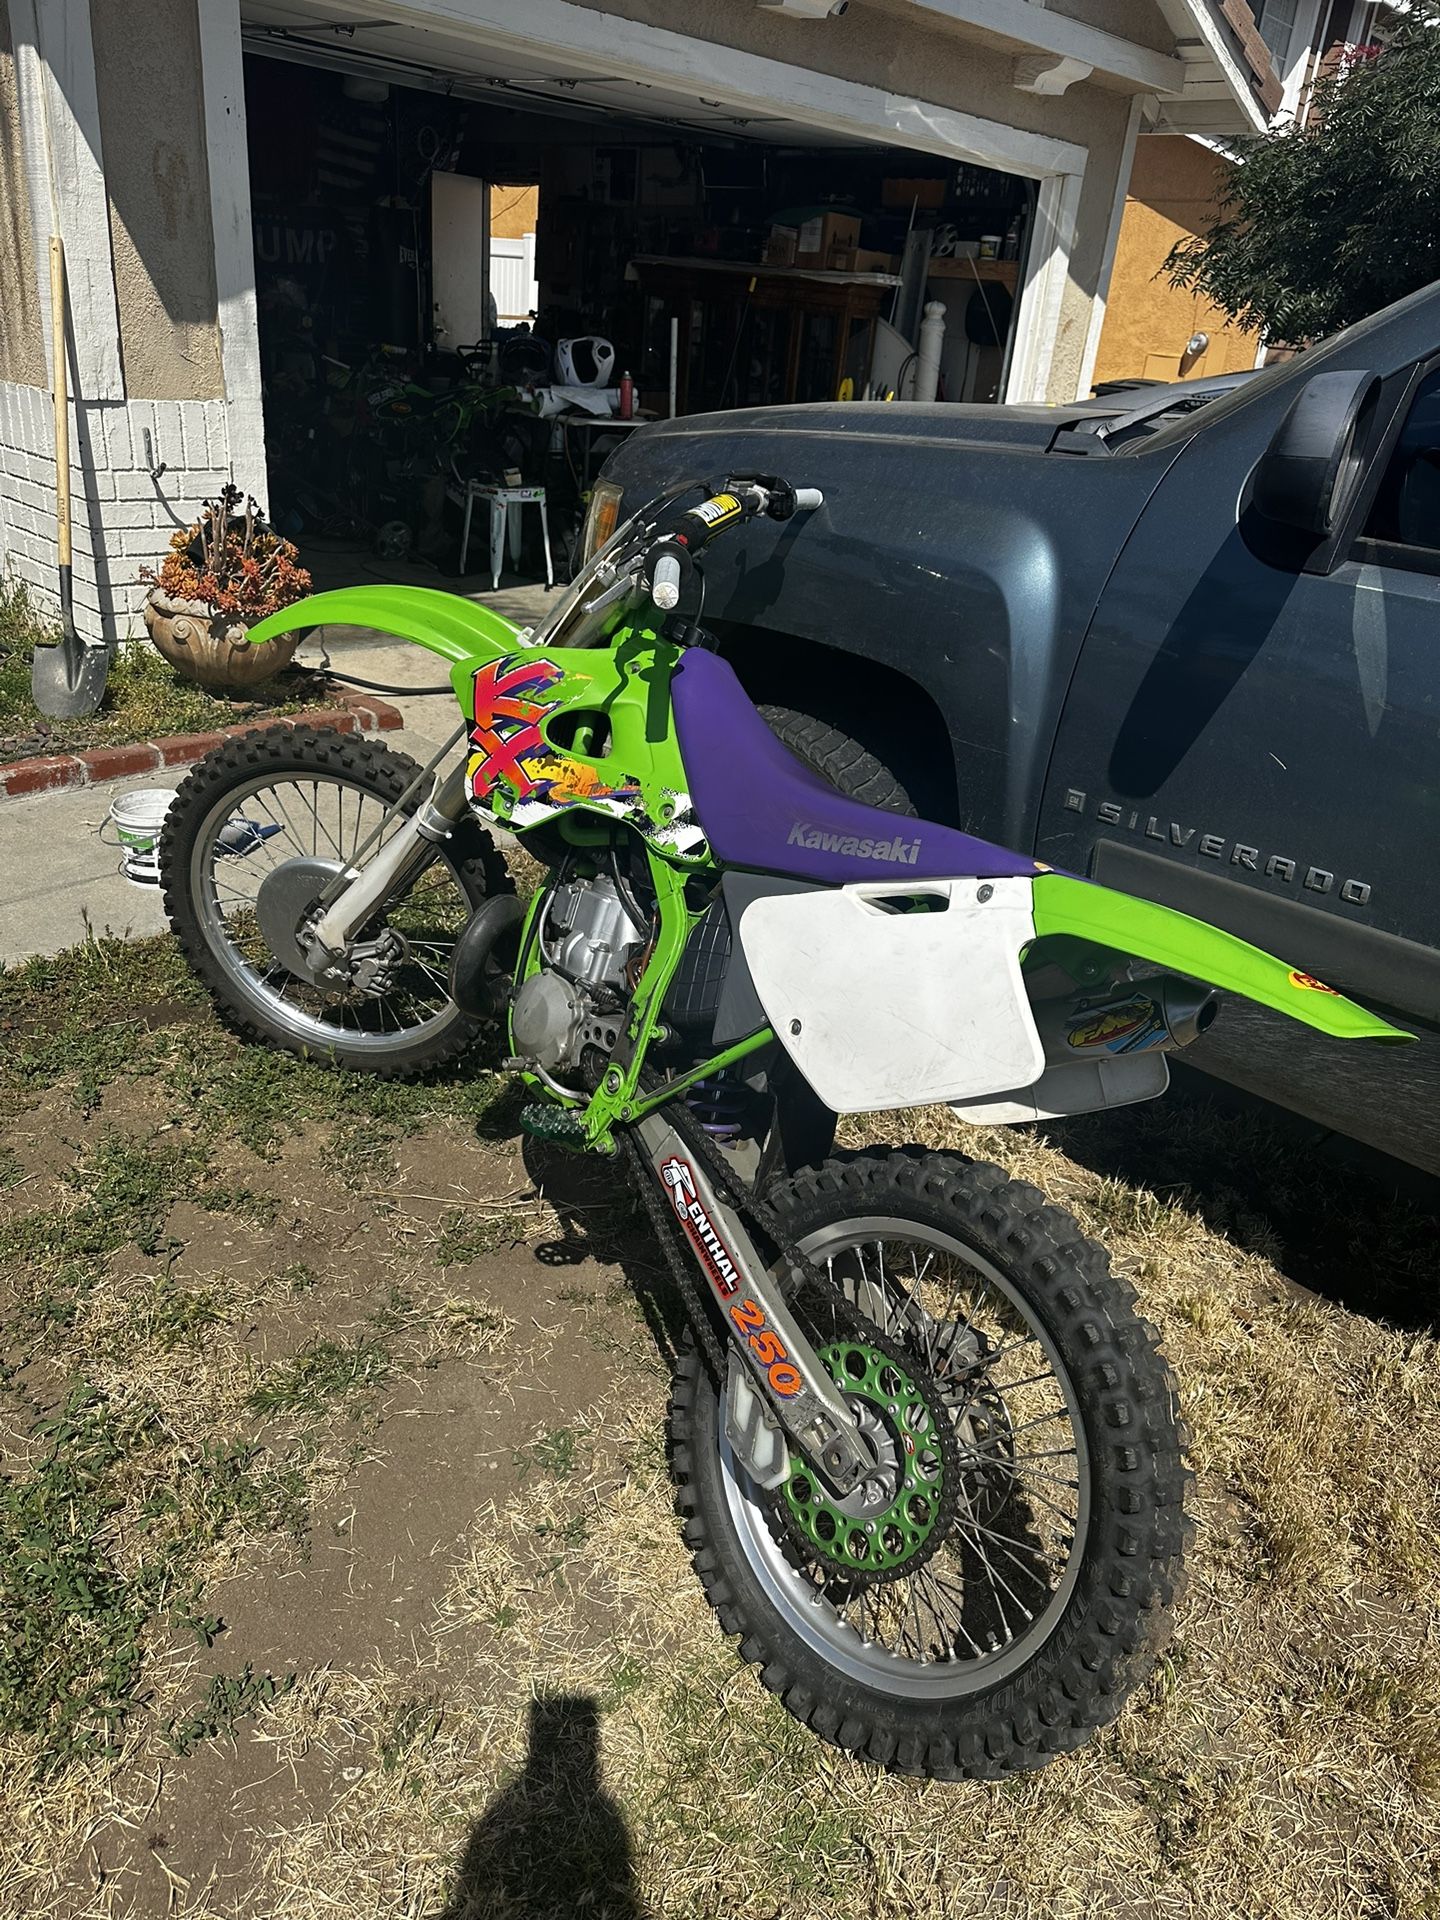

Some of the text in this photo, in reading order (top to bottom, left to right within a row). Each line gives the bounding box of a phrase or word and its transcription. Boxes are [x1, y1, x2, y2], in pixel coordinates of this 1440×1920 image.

[469, 655, 563, 798] KX
[787, 822, 921, 865] Kawasaki
[1098, 802, 1371, 905] SILVERADO
[730, 1299, 802, 1398] 250
